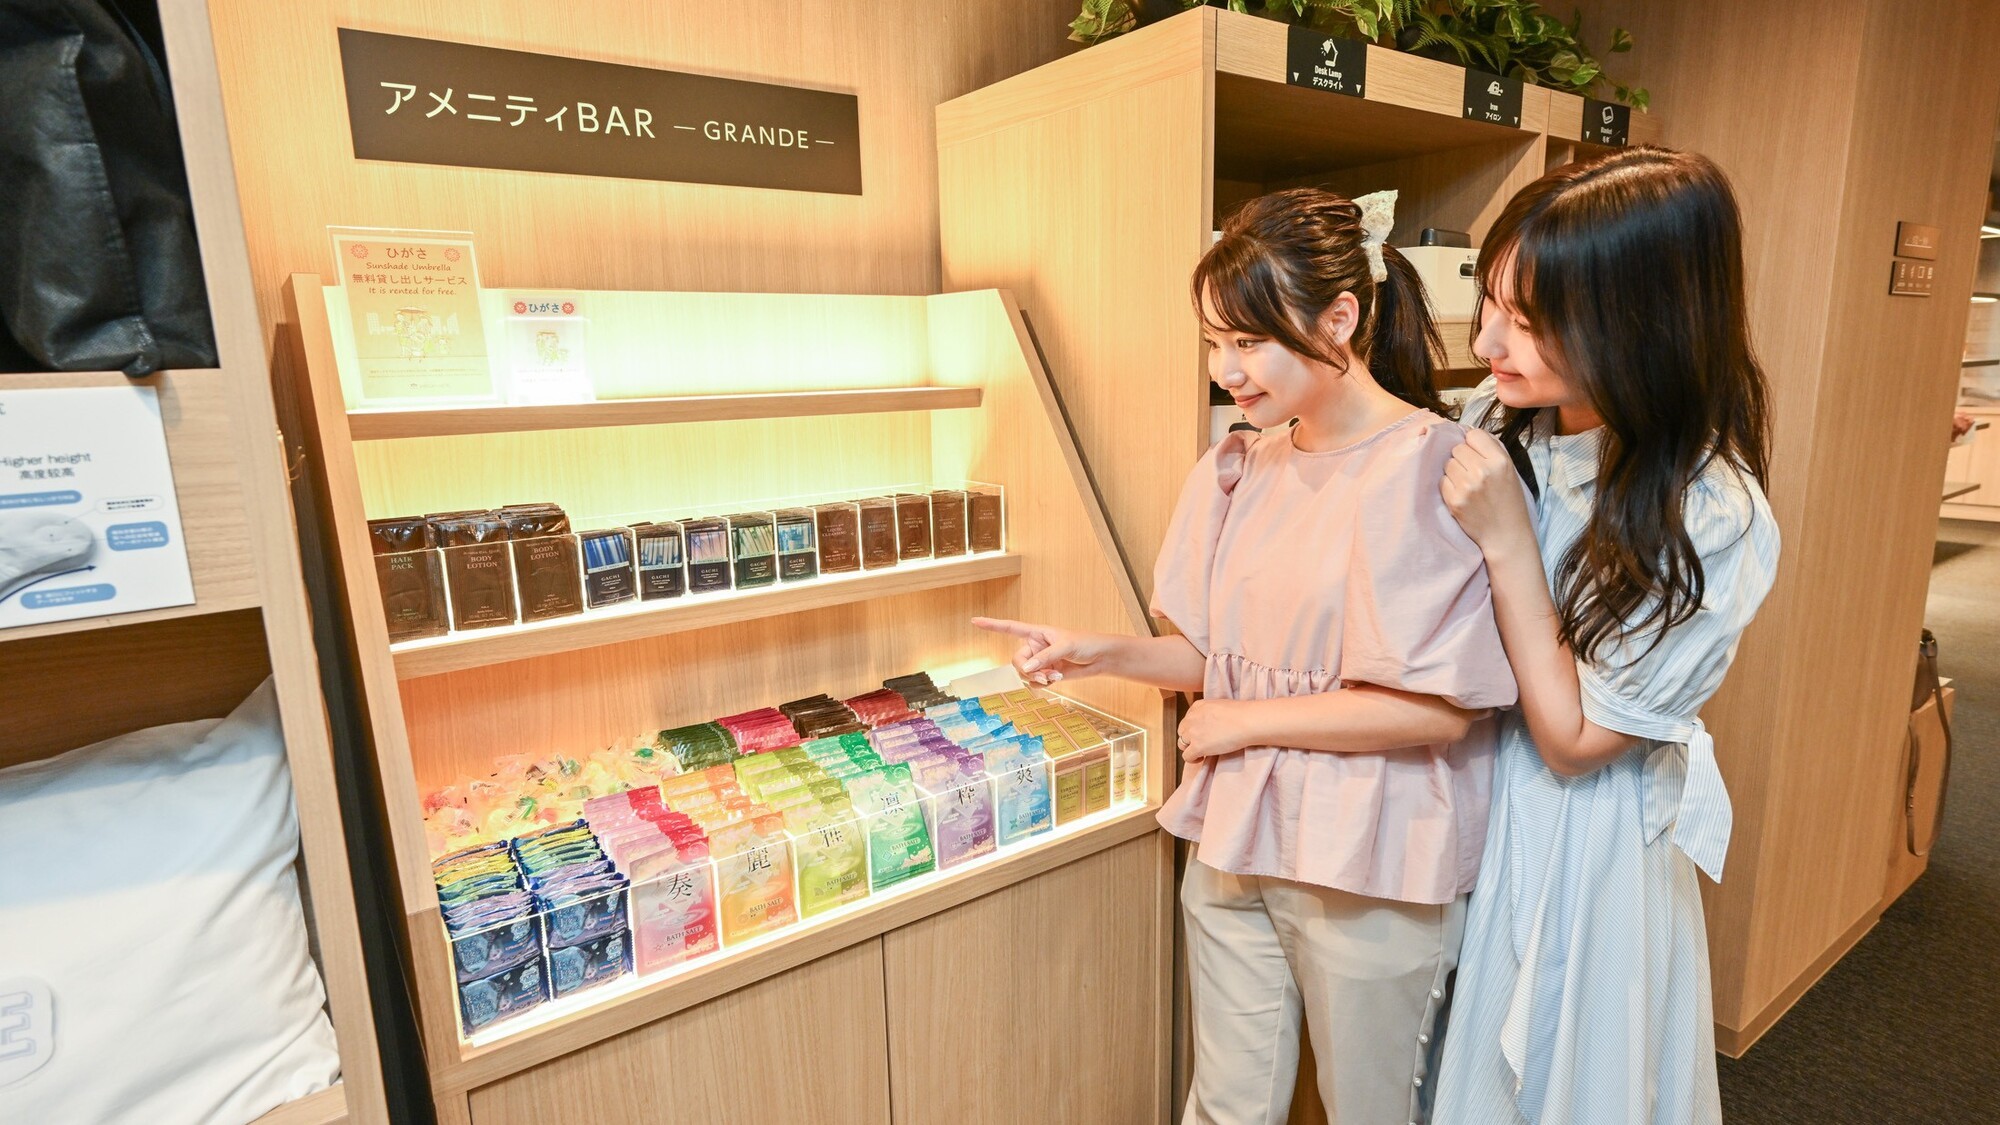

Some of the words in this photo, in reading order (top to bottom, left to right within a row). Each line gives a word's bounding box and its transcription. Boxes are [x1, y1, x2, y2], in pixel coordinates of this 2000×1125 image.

[1314, 65, 1328, 76] Desk
[1328, 68, 1343, 81] Lamp
[1313, 76, 1343, 90] デスクライト
[380, 81, 655, 139] アメニティBAR
[1485, 112, 1501, 121] アイロン
[386, 247, 427, 260] ひがさ
[366, 262, 408, 271] Sunshade
[412, 263, 451, 272] Umbrella
[352, 273, 467, 285] 無料貸し出しサービス
[422, 287, 435, 295] for
[529, 303, 560, 313] ひがさ
[48, 453, 91, 464] height
[20, 468, 74, 480] 高度较高
[533, 545, 554, 553] BODY
[390, 556, 413, 564] HAIR
[530, 551, 559, 560] LOTION
[391, 562, 414, 570] PACK
[466, 561, 498, 569] LOTION
[1016, 764, 1034, 785] 爽
[747, 846, 772, 873] 麗
[667, 872, 693, 900] 奏
[826, 877, 841, 887] BATH
[841, 873, 856, 882] SALT
[749, 903, 767, 913] BATH
[767, 898, 781, 907] SALT
[666, 931, 684, 941] BATH
[685, 926, 700, 935] SALT
